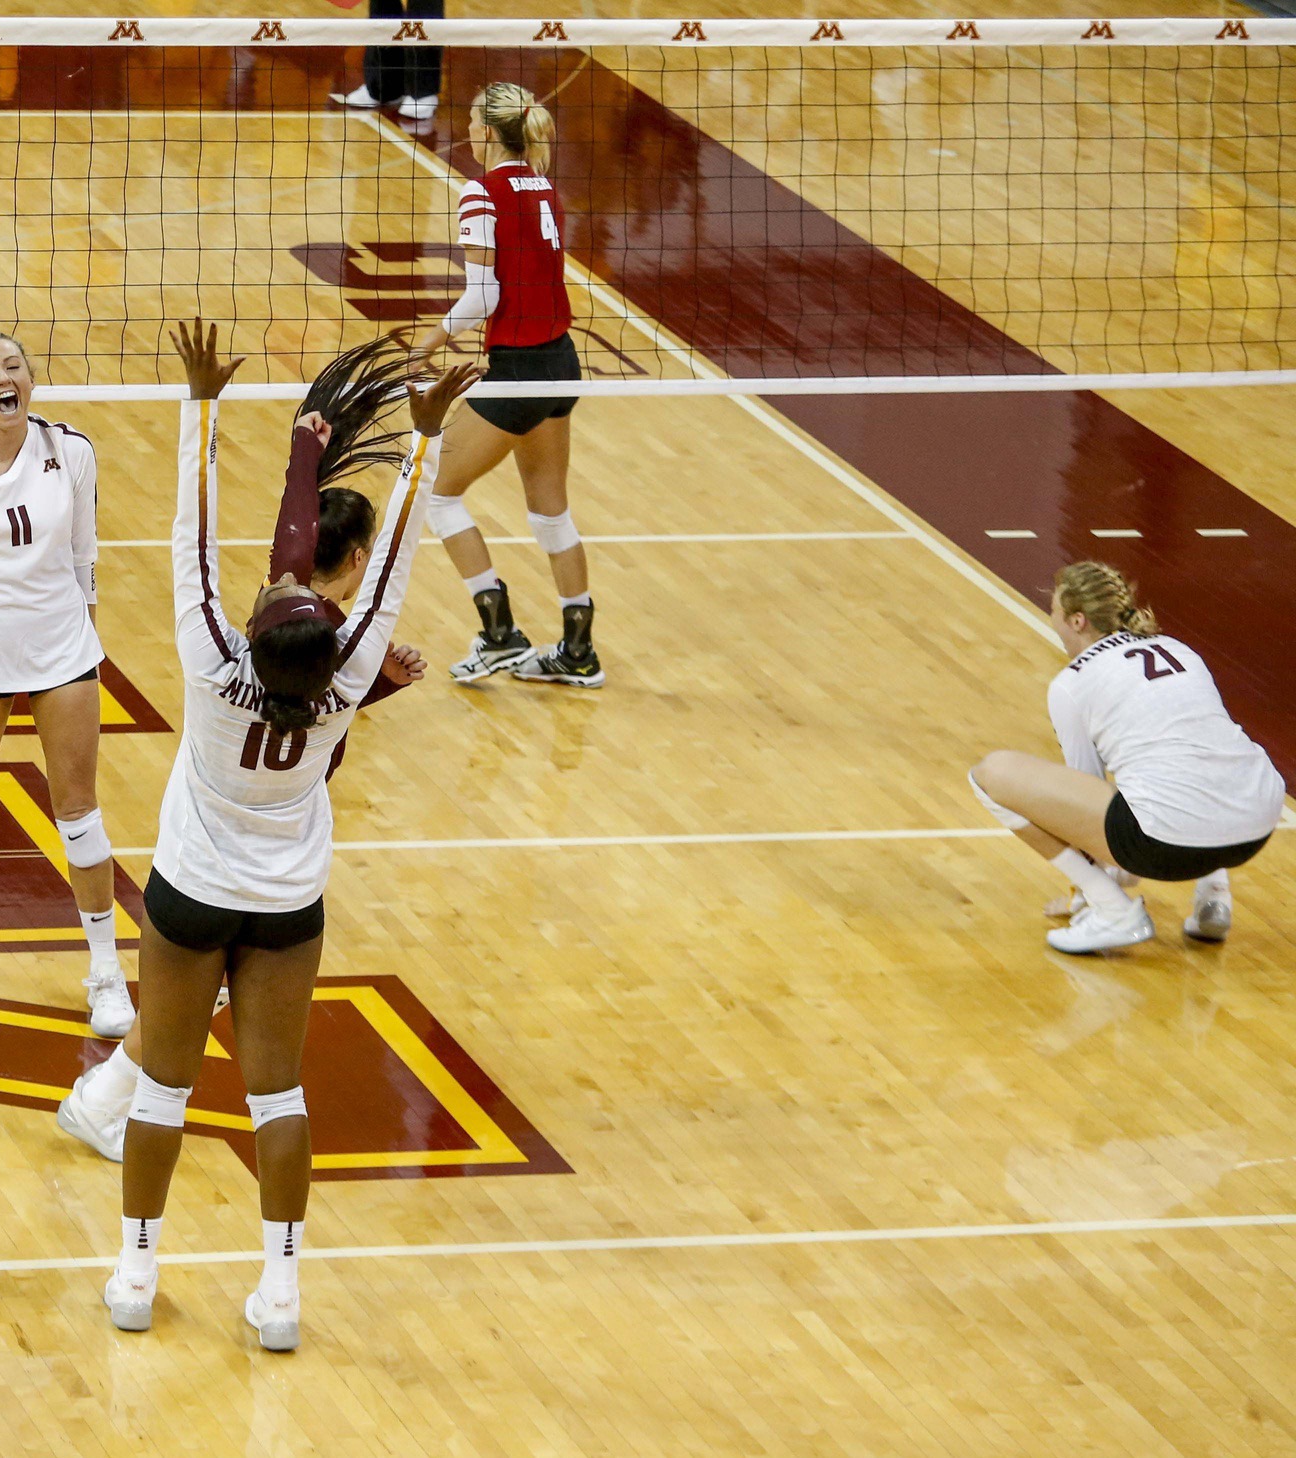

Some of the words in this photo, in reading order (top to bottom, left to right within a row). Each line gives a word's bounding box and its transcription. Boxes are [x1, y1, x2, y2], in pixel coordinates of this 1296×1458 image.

[108, 21, 144, 41] M
[251, 21, 287, 41] M
[392, 21, 428, 41] M
[533, 21, 568, 41] M
[672, 21, 707, 41] M
[810, 21, 844, 41] M
[946, 21, 980, 40] M
[1081, 21, 1115, 39] M
[1215, 21, 1250, 40] M
[539, 200, 561, 250] 4
[43, 458, 62, 473] M
[6, 504, 33, 546] 11
[1124, 644, 1187, 681] 21
[218, 677, 350, 715] MINTA
[239, 721, 307, 771] 10
